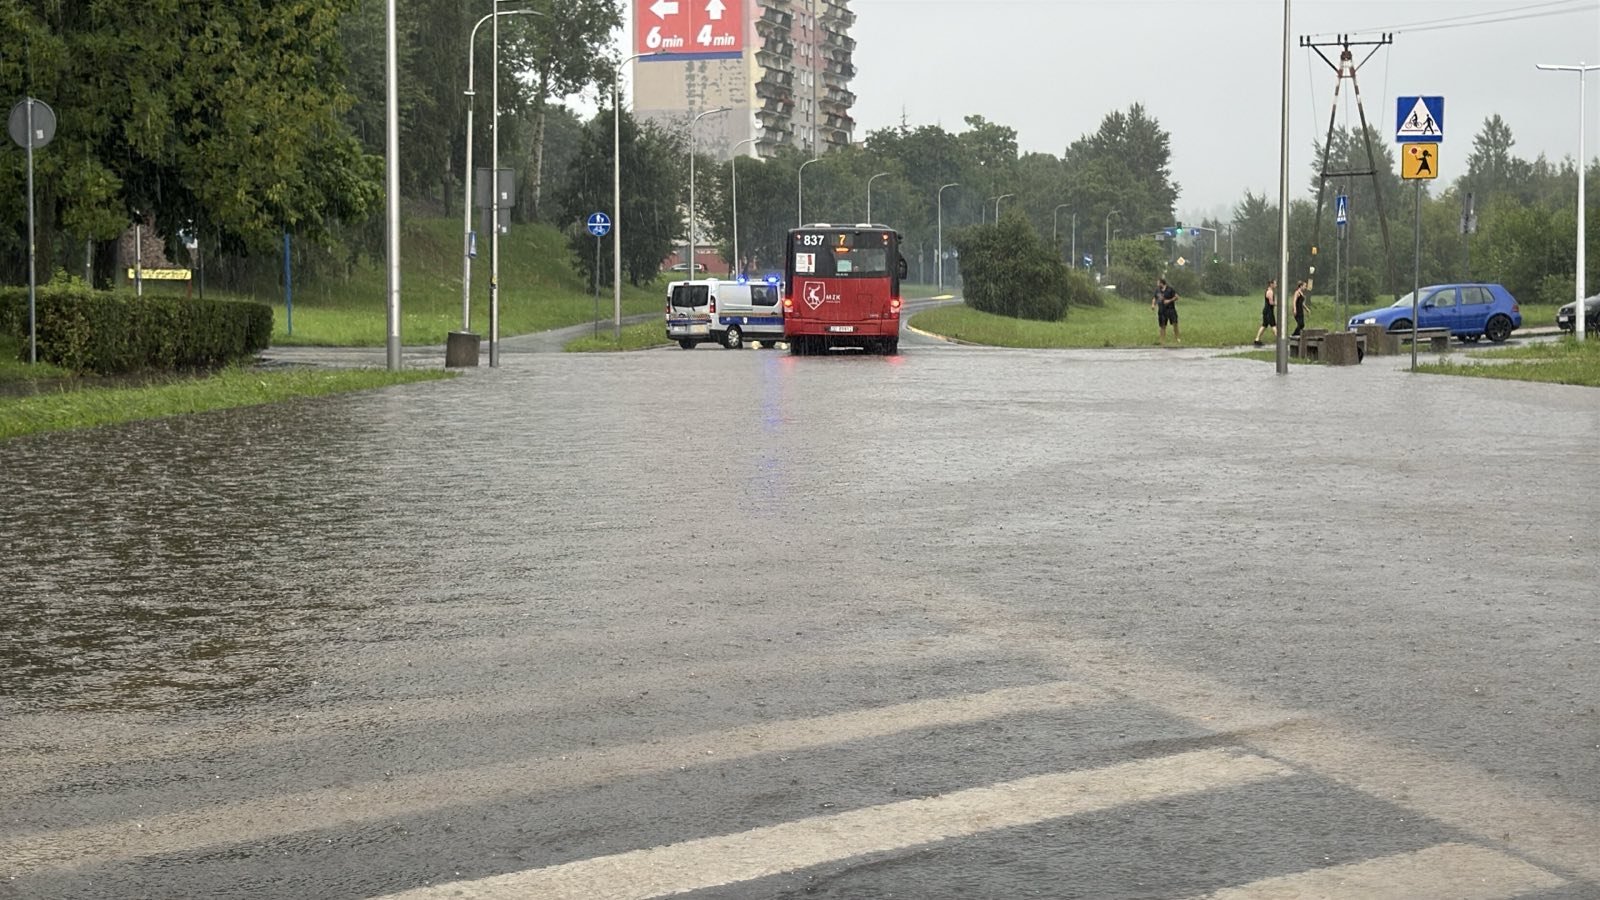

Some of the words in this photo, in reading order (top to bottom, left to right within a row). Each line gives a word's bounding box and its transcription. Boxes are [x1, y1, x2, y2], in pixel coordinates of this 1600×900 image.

[646, 26, 661, 48] 6
[662, 35, 683, 48] min
[697, 24, 712, 46] 4
[713, 33, 735, 46] min
[803, 234, 825, 246] 837
[839, 234, 846, 246] 7
